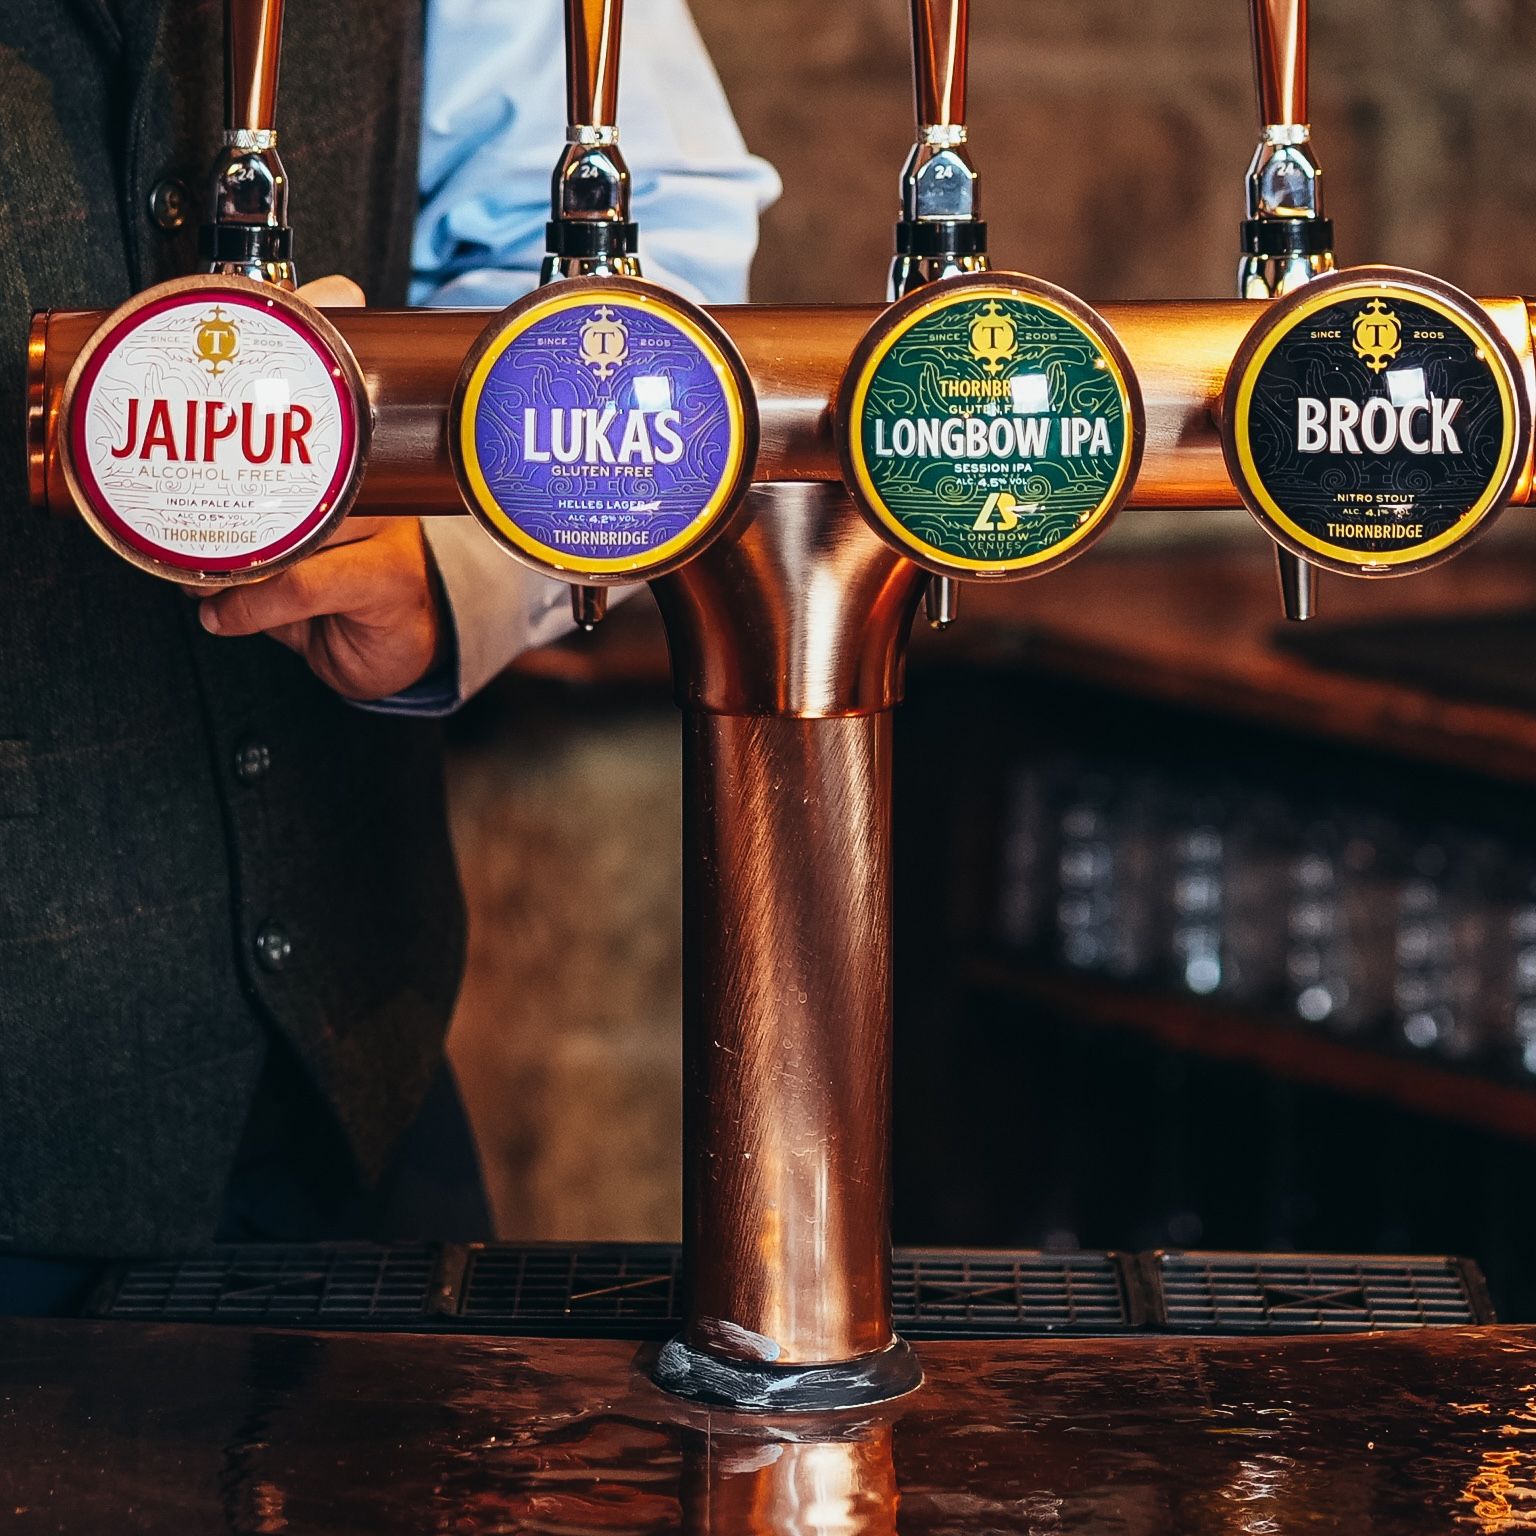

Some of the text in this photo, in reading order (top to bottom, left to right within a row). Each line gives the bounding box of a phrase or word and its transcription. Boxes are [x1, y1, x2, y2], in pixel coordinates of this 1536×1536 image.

[238, 168, 255, 181] 24
[581, 165, 598, 178] 24
[935, 165, 953, 179] 24
[150, 335, 283, 347] SINCE 2005
[929, 332, 1057, 341] SINCE 2005
[981, 325, 1004, 349] T
[1310, 330, 1445, 340] SINCE 2005
[1365, 324, 1388, 347] T
[205, 330, 228, 354] T
[537, 337, 671, 347] SINCE 2005
[593, 331, 615, 355] T
[939, 379, 1014, 398] THORNBR
[111, 398, 312, 464] JAIPUR
[1297, 397, 1463, 455] BROCK
[523, 408, 684, 464] LUKAS
[874, 416, 1113, 459] LONGBOW IPA
[138, 466, 286, 482] ALCOHOL FREE
[551, 465, 653, 478] GLUTEN FREE
[954, 463, 1033, 473] SESSION IPA
[977, 477, 1007, 487] 4.5%
[166, 498, 198, 507] INDIA
[201, 499, 229, 508] PALE
[558, 499, 604, 510] HELLES
[1337, 493, 1415, 503] NITRO STOUT
[198, 513, 224, 521] 0.5%
[589, 515, 617, 523] 4.2%
[1365, 508, 1389, 517] 4.1%
[162, 527, 257, 543] THORNBRIDGE
[553, 529, 649, 545] THORNBRIDGE
[959, 532, 1030, 541] LONGBOW
[1327, 523, 1423, 539] THORNBRIDGE
[968, 541, 1022, 550] VENUES
